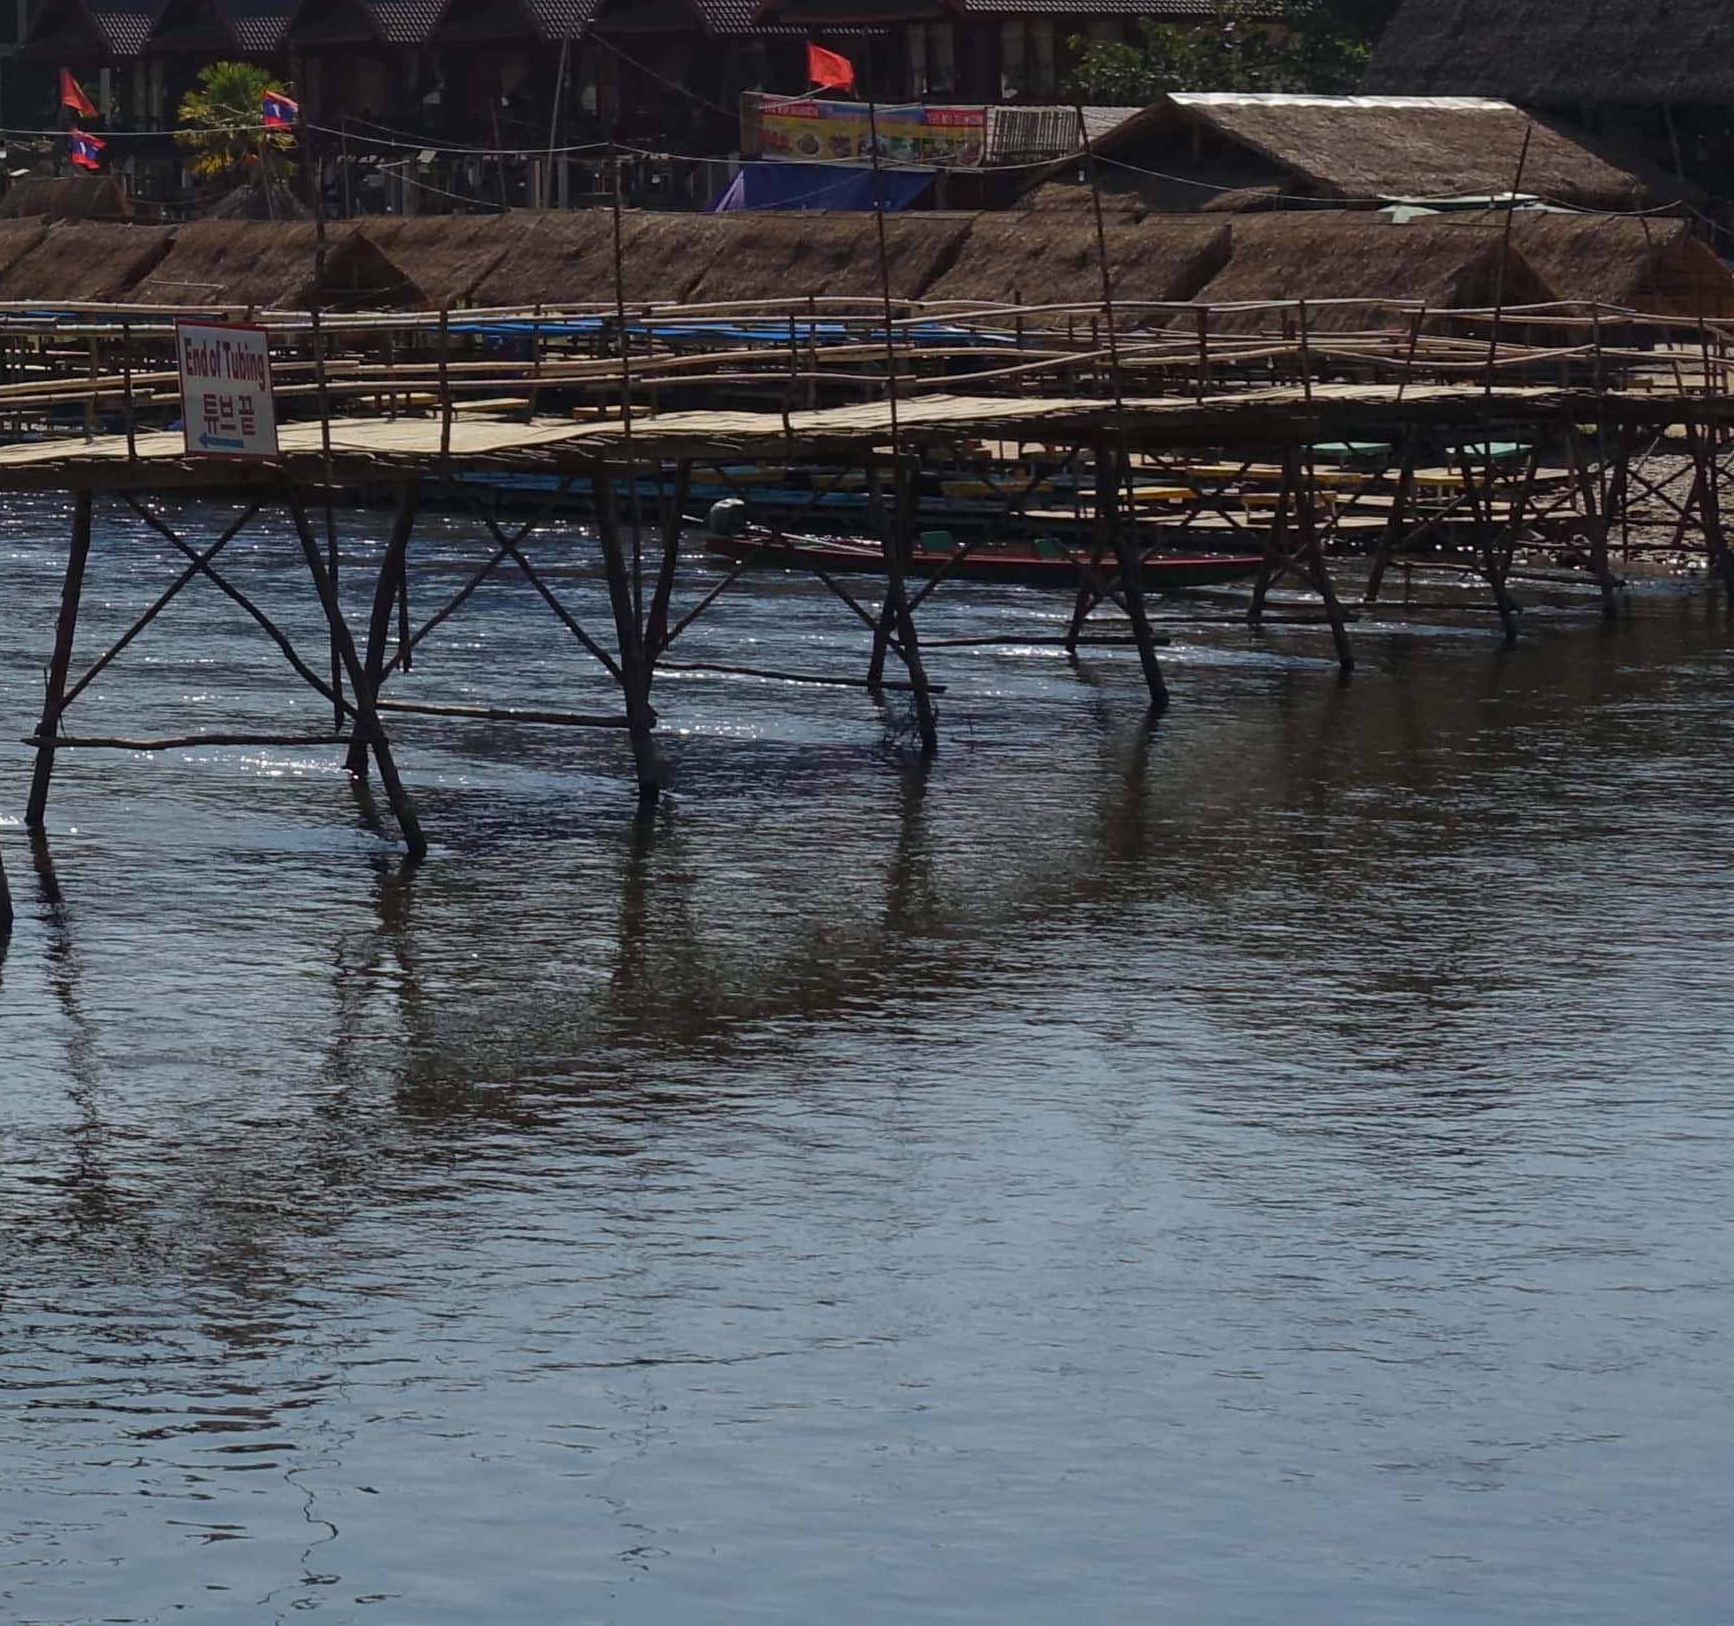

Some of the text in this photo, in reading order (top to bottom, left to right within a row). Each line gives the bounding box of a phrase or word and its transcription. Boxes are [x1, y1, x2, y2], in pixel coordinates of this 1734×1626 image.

[184, 337, 266, 392] End of Tubing
